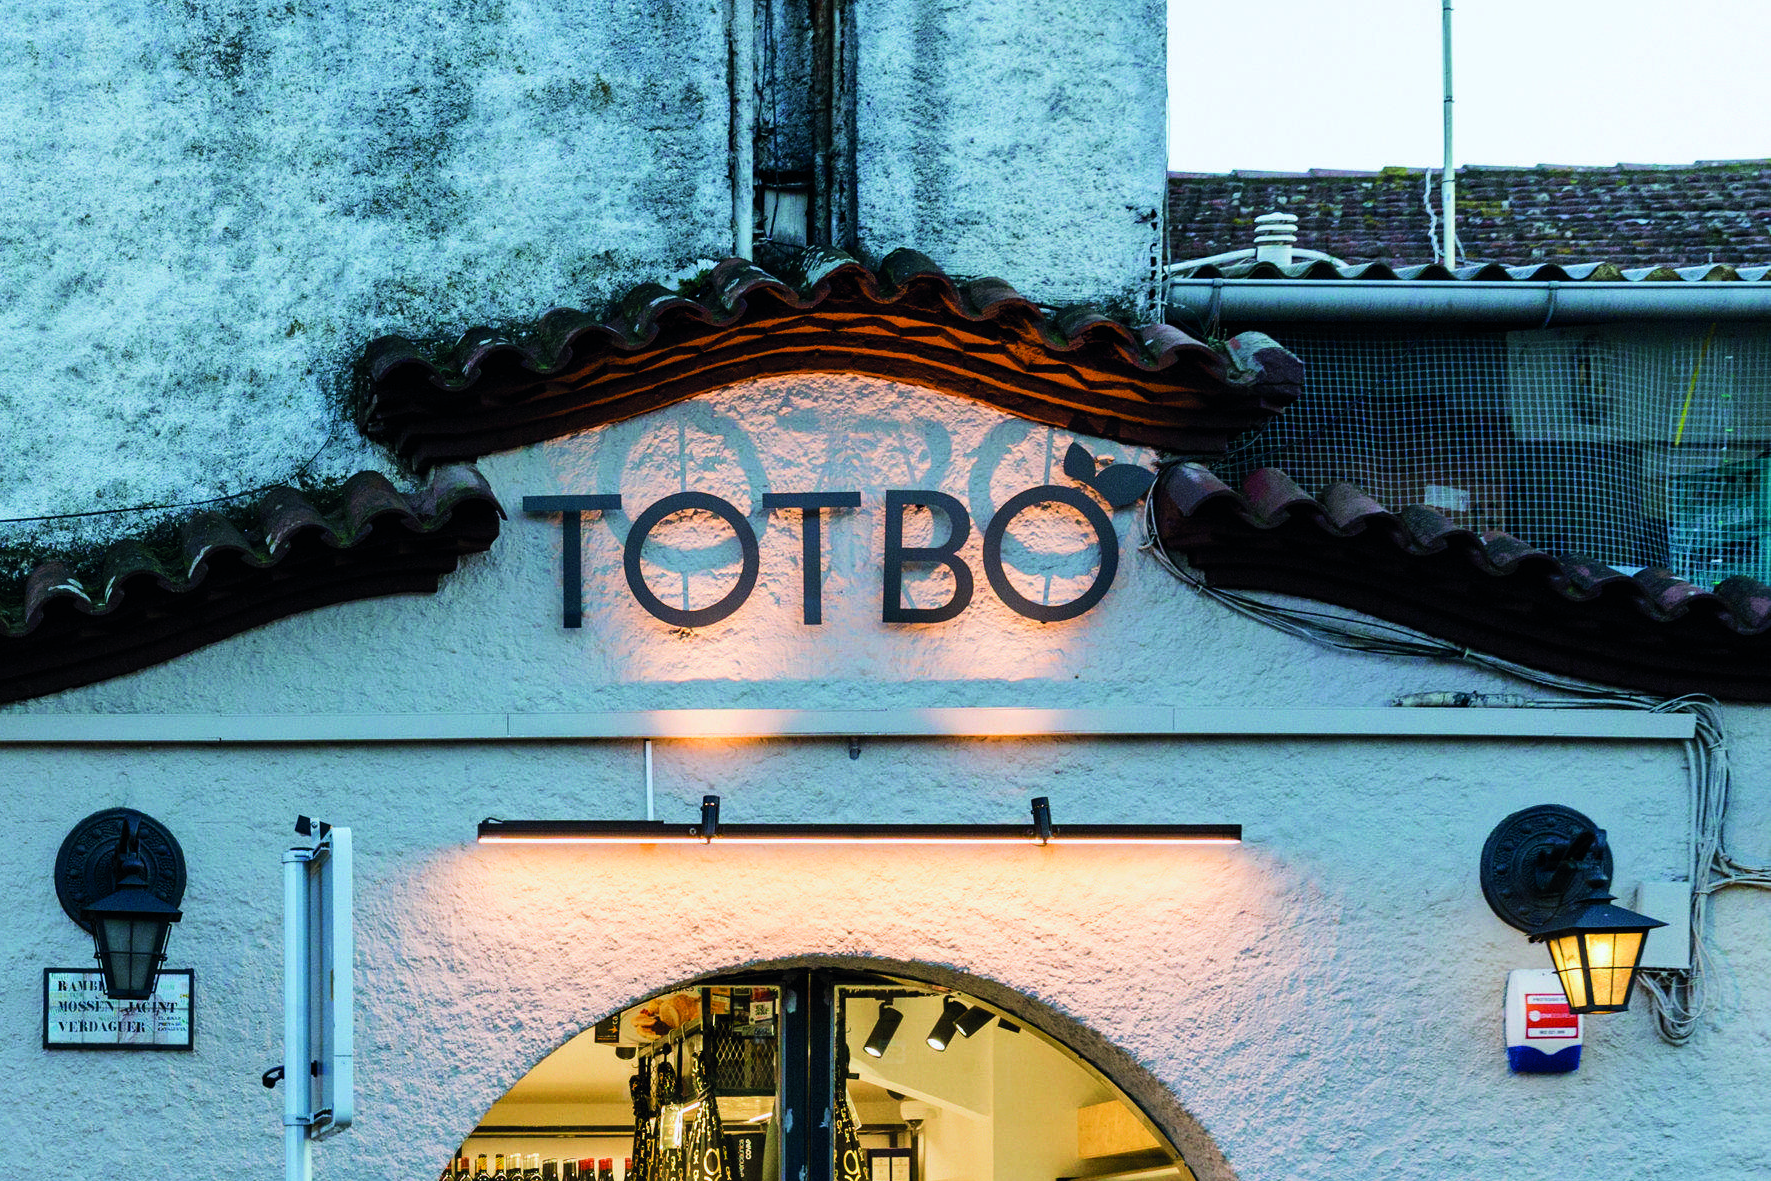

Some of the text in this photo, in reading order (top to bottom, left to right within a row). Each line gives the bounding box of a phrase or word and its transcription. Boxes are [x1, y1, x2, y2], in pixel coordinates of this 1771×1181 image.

[523, 491, 860, 627] TOT
[127, 1000, 178, 1013] JACINT
[58, 1020, 146, 1033] VERDAGUER
